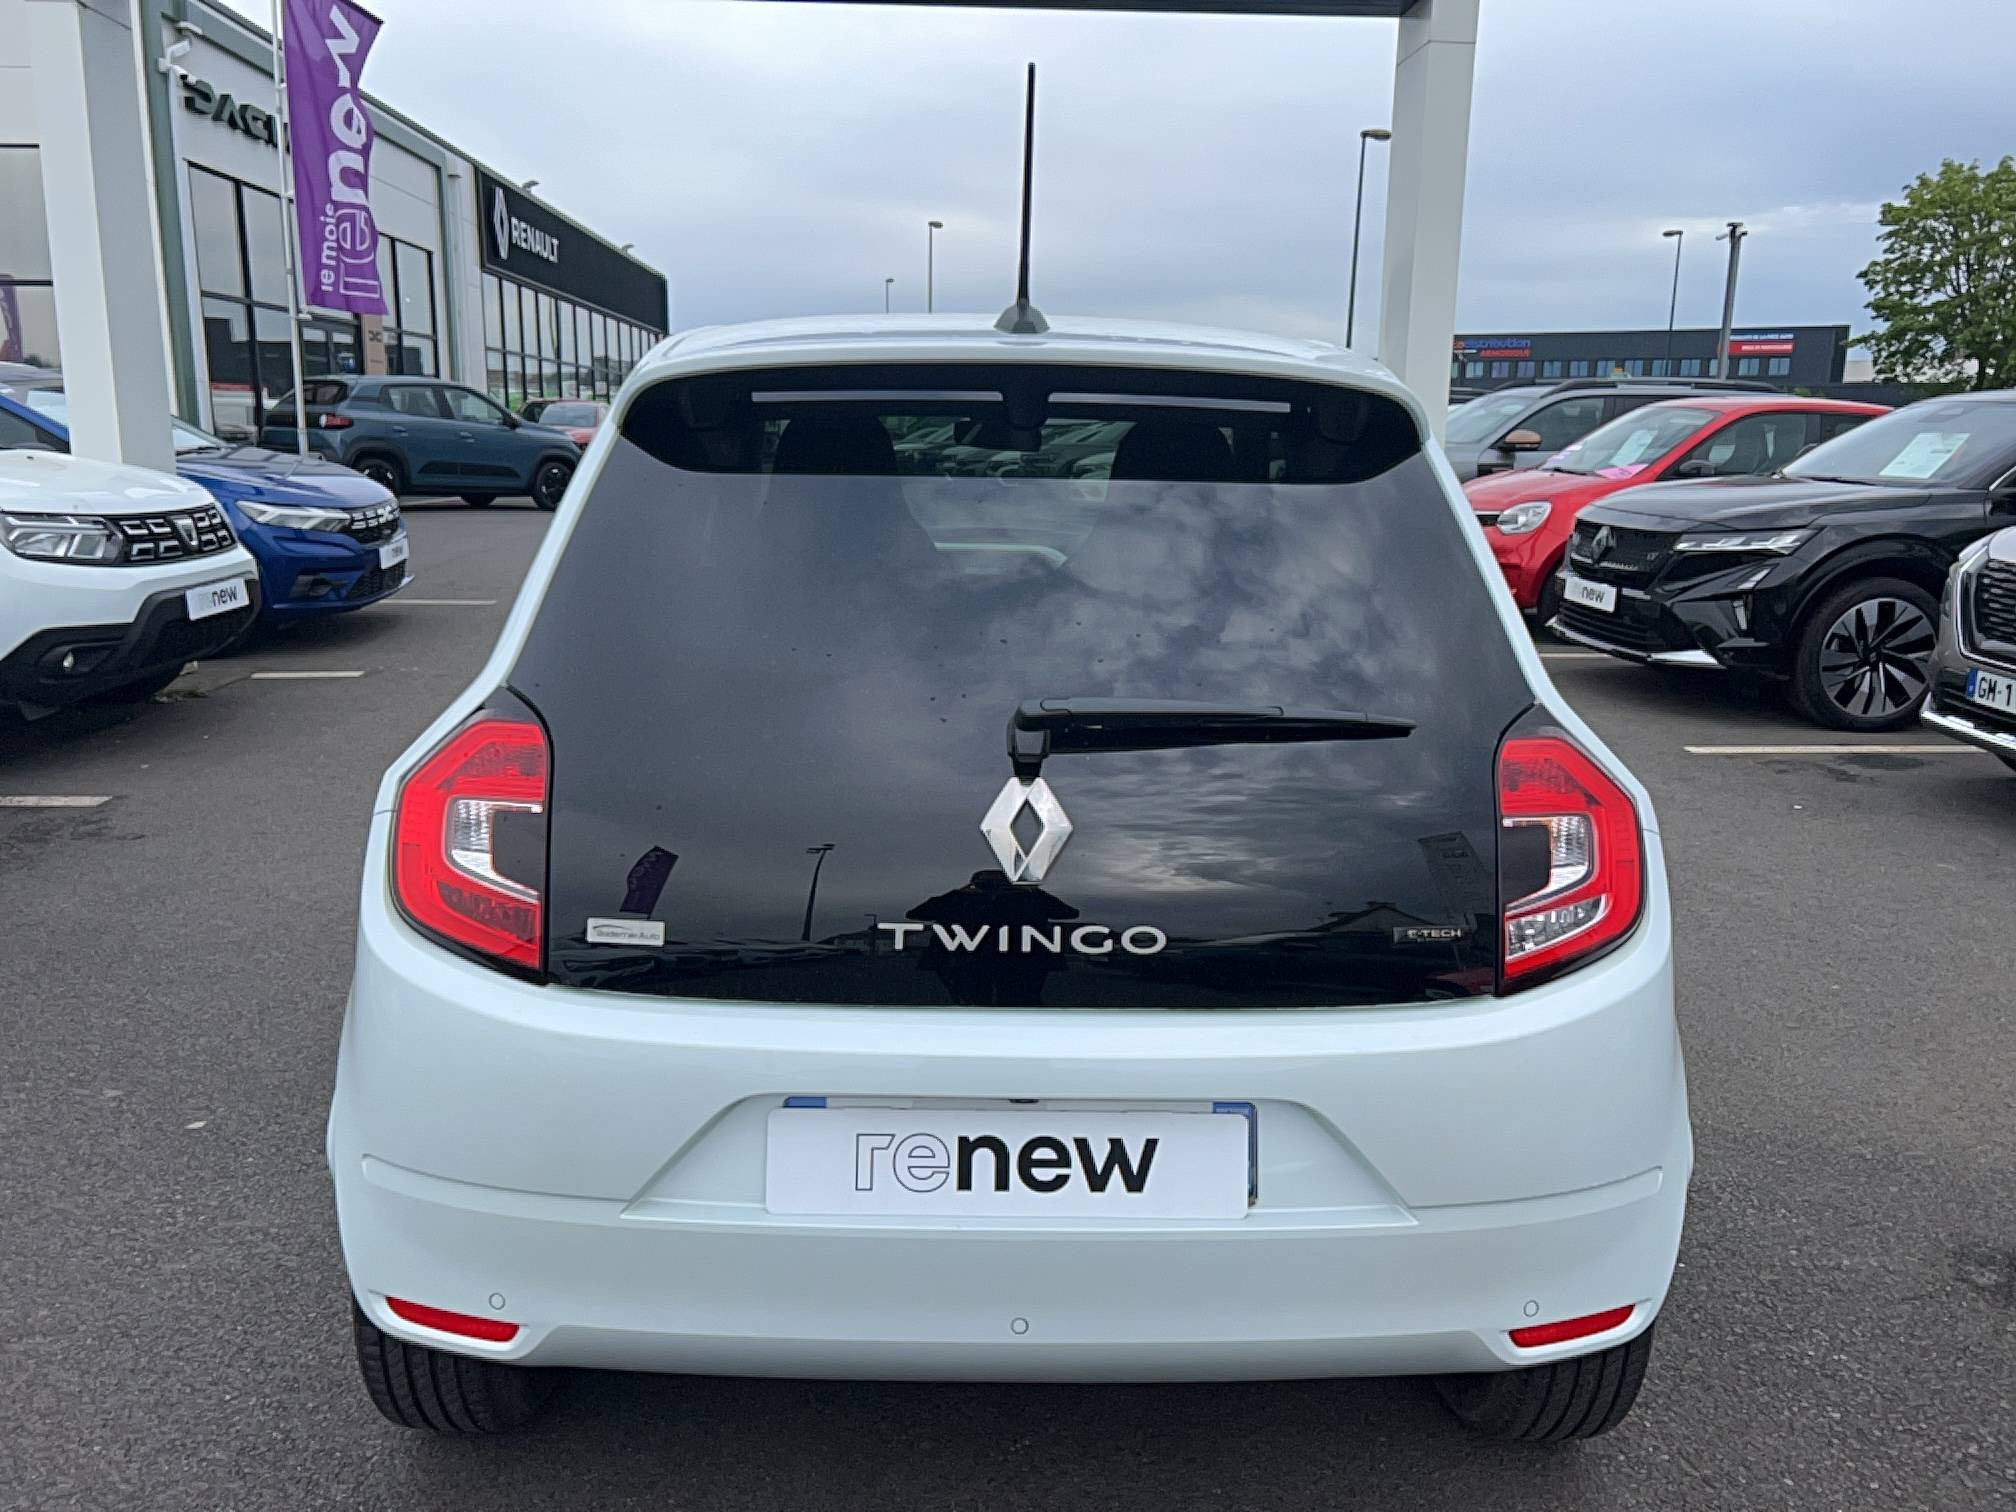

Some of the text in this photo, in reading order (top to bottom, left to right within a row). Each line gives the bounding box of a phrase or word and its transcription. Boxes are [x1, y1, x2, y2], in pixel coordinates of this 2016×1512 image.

[511, 217, 559, 263] RENAULT
[320, 267, 335, 291] le
[877, 922, 1168, 954] TWINGO
[855, 1132, 1160, 1193] renew
